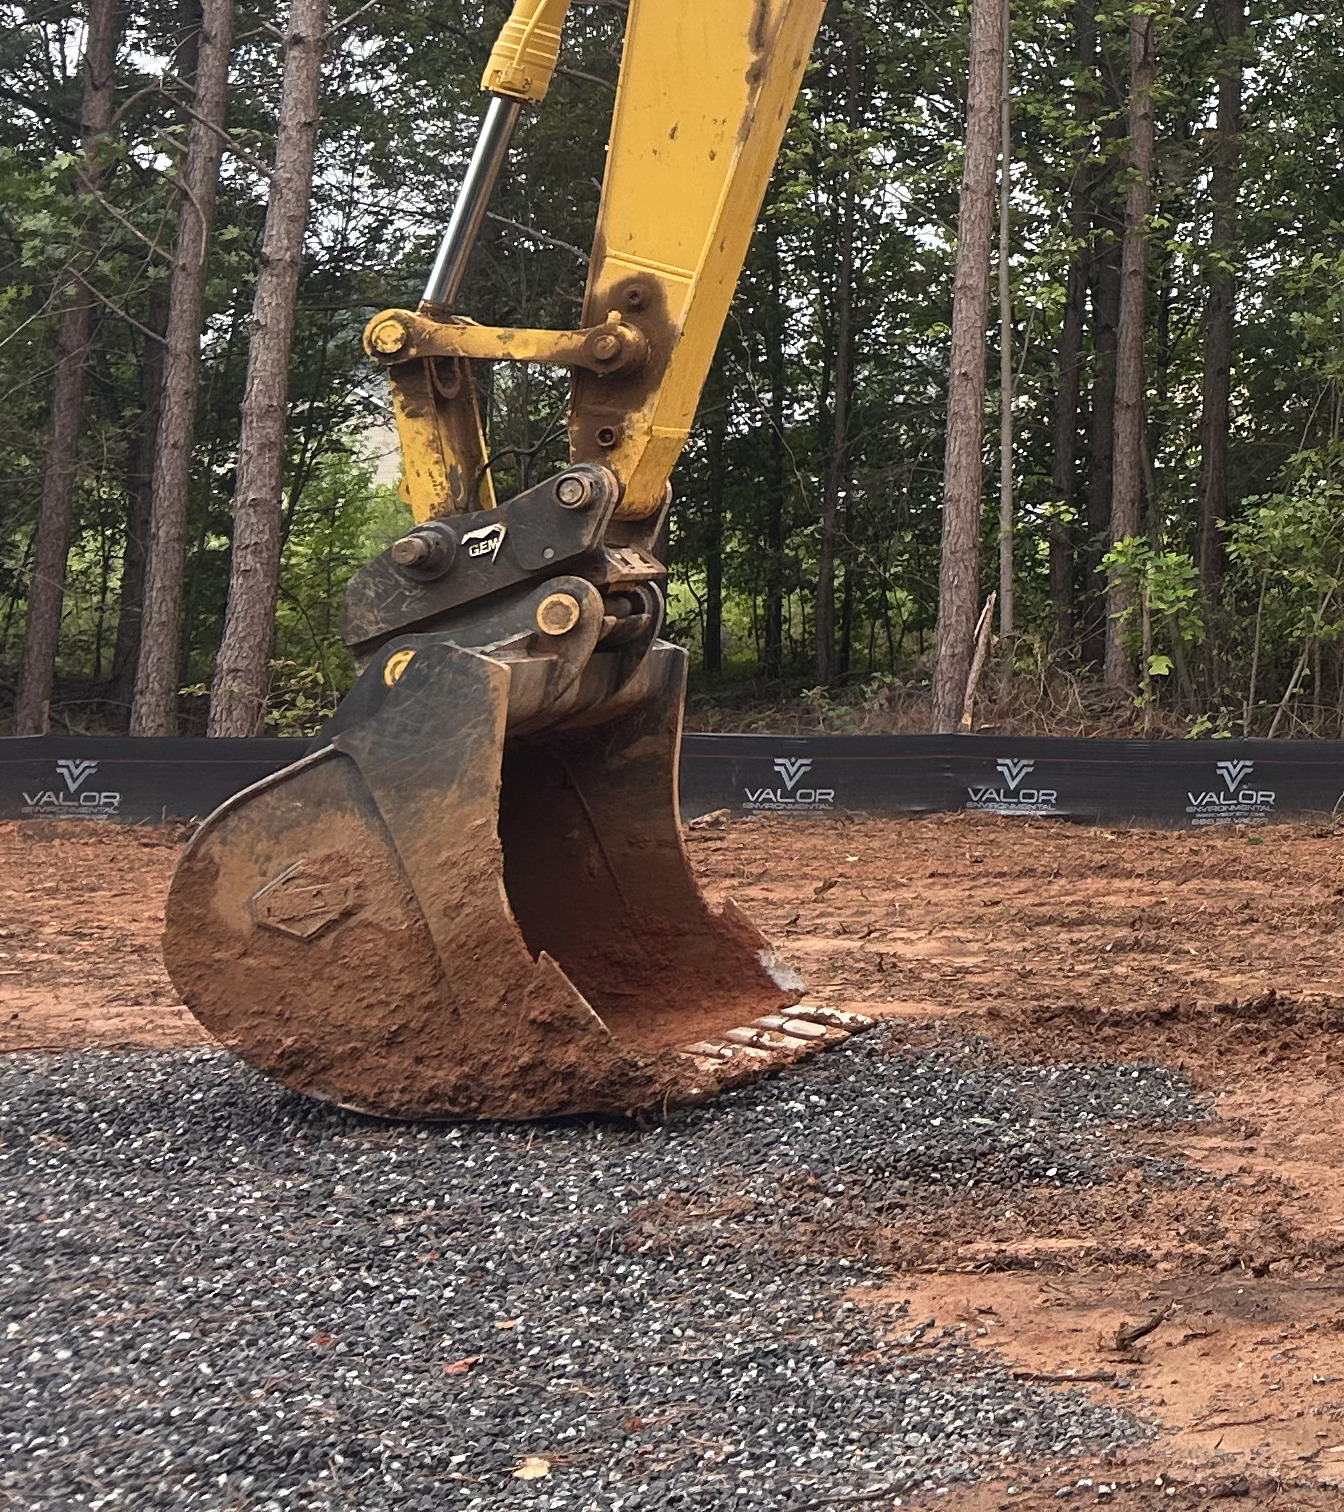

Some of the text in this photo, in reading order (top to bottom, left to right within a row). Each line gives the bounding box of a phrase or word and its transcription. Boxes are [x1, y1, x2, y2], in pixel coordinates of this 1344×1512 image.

[469, 537, 501, 557] GEM
[22, 790, 121, 807] VALOR
[744, 787, 835, 803] VALOR
[967, 787, 1058, 803] VALOR
[1187, 790, 1276, 806] VALOR
